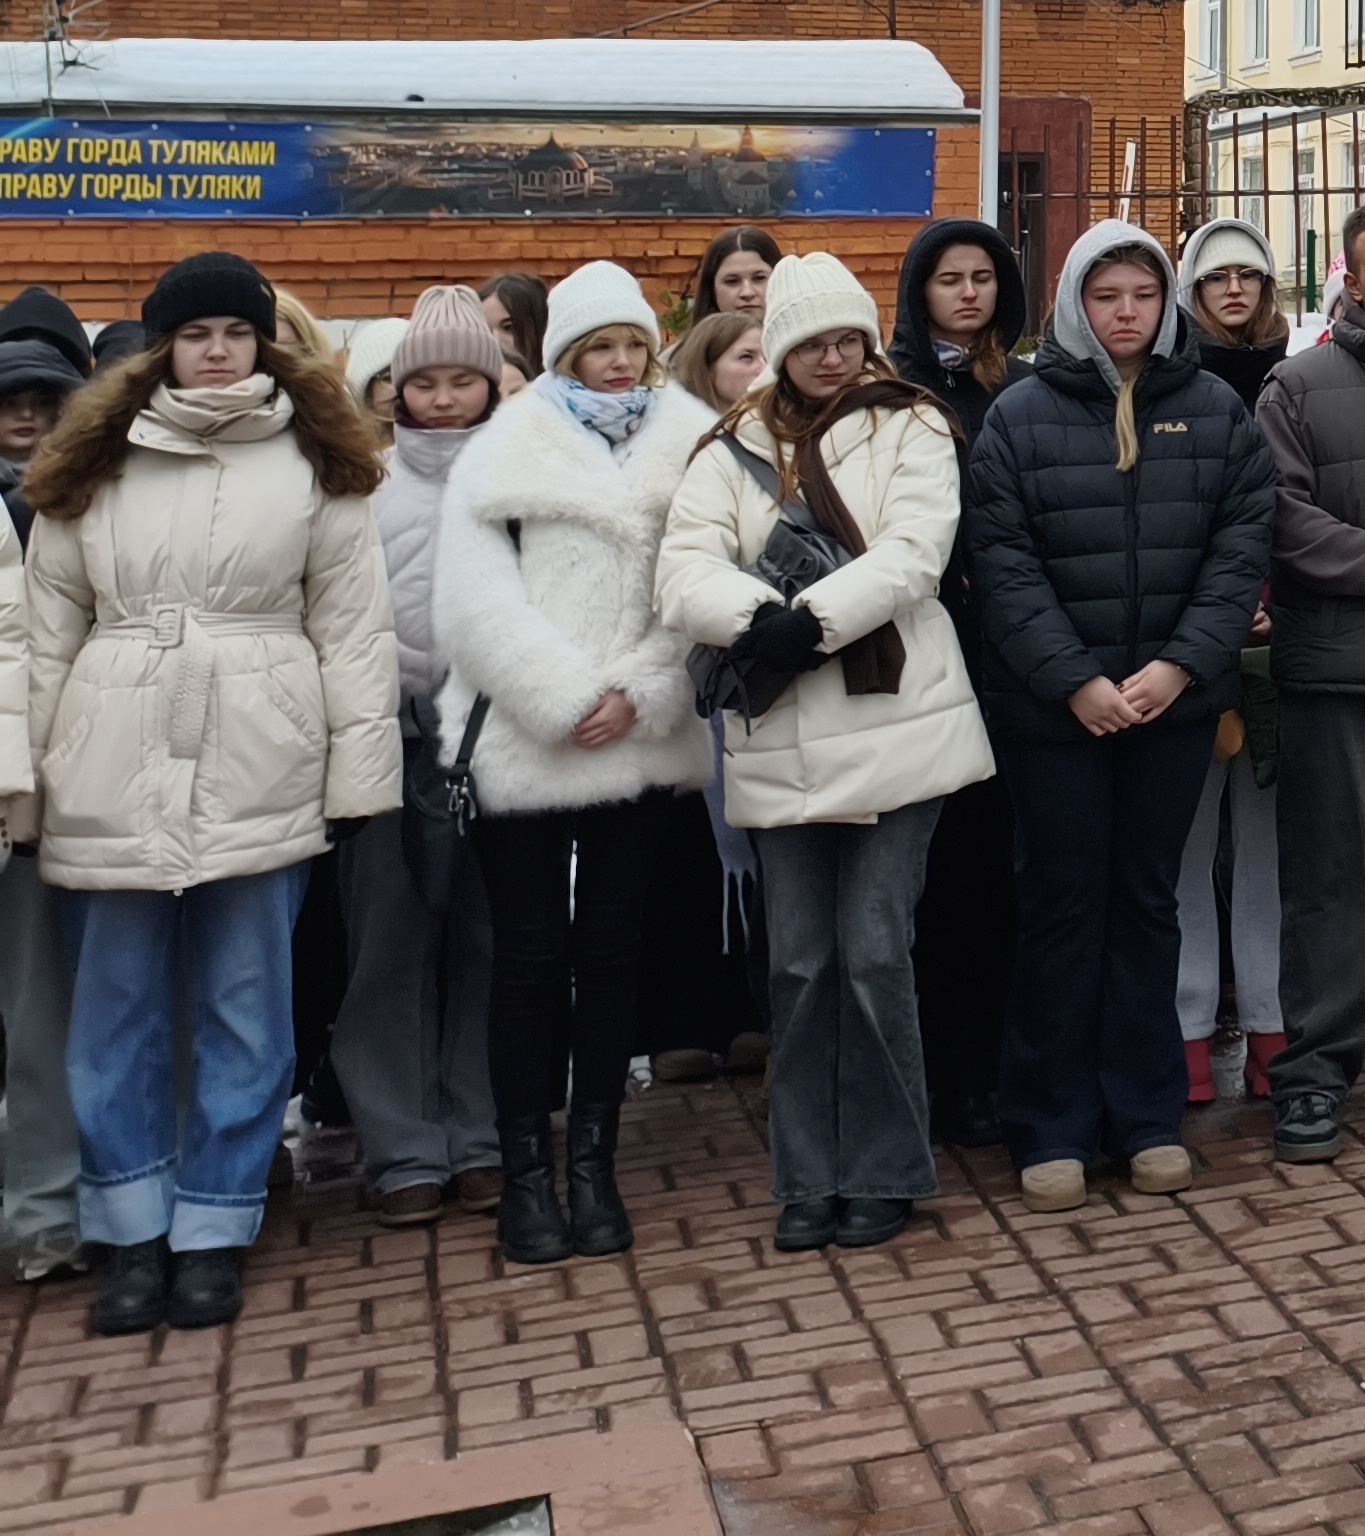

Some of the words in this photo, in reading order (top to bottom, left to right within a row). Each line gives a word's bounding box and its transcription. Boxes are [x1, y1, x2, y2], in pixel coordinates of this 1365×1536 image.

[67, 138, 142, 166] ГОРДА
[148, 140, 276, 166] ТУЛЯКАМИ
[0, 173, 75, 199] ПРАВУ
[81, 173, 162, 201] ГОРДЫ
[168, 174, 262, 200] ТУЛЯКИ
[1153, 421, 1188, 434] FILA
